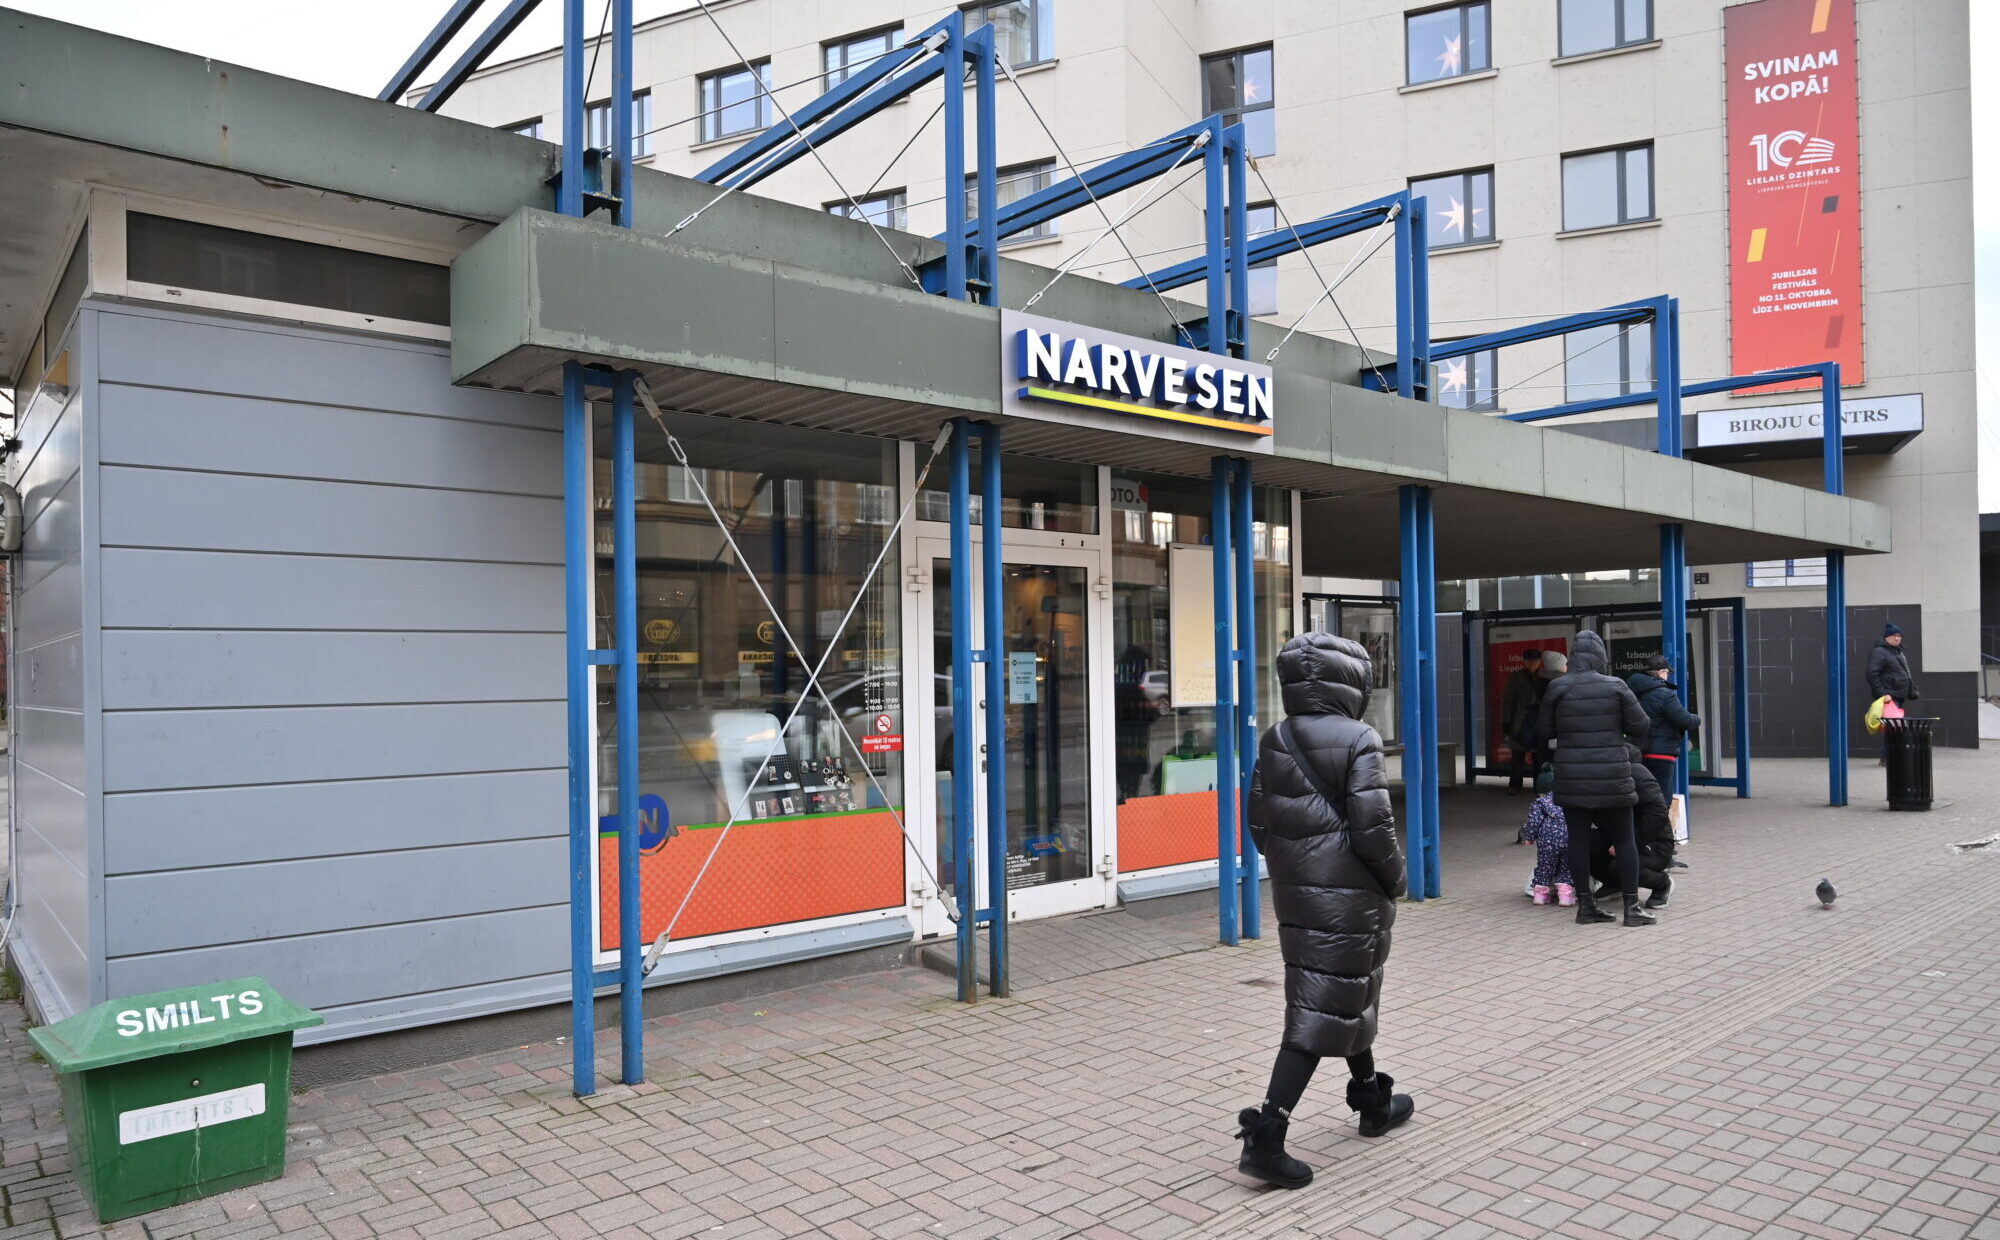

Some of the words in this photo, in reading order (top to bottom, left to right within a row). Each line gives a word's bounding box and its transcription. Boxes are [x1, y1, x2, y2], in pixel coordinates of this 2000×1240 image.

[1744, 49, 1839, 81] SVINAM
[1755, 74, 1829, 105] KOPĀ!
[1746, 174, 1785, 186] LIELAIS
[1788, 166, 1841, 179] DZINTARS
[1771, 267, 1817, 280] JUBILEJAS
[1772, 278, 1817, 291] FESTIVĀLS
[1752, 304, 1773, 315] LĪDZ
[1774, 304, 1782, 312] 8.
[1783, 298, 1839, 311] NOVEMBRIM
[1759, 294, 1773, 303] NO
[1774, 293, 1787, 302] 11.
[1788, 288, 1832, 300] OKTOBRA
[1018, 327, 1273, 420] NARVESEN
[1729, 415, 1802, 434] BIROJU
[1808, 408, 1889, 428] CNTRS
[116, 990, 264, 1037] SMILTS
